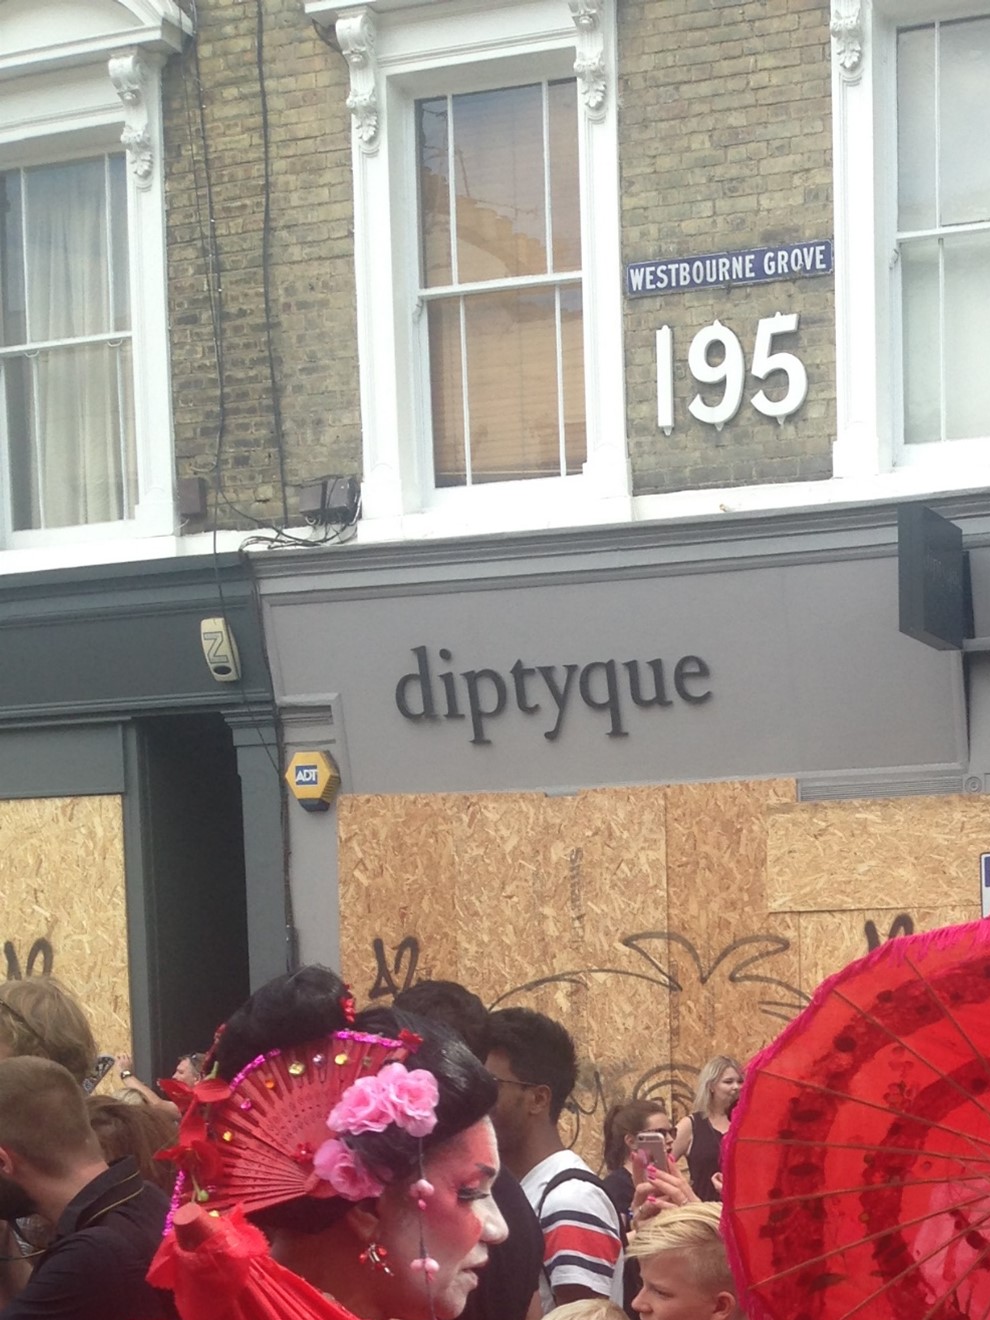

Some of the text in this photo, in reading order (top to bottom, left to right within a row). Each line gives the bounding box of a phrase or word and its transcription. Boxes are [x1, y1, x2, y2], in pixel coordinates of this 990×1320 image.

[630, 245, 826, 291] WESTBOURNE GROVE
[656, 312, 808, 435] 195
[395, 645, 713, 745] diptyque
[296, 768, 318, 783] ADT
